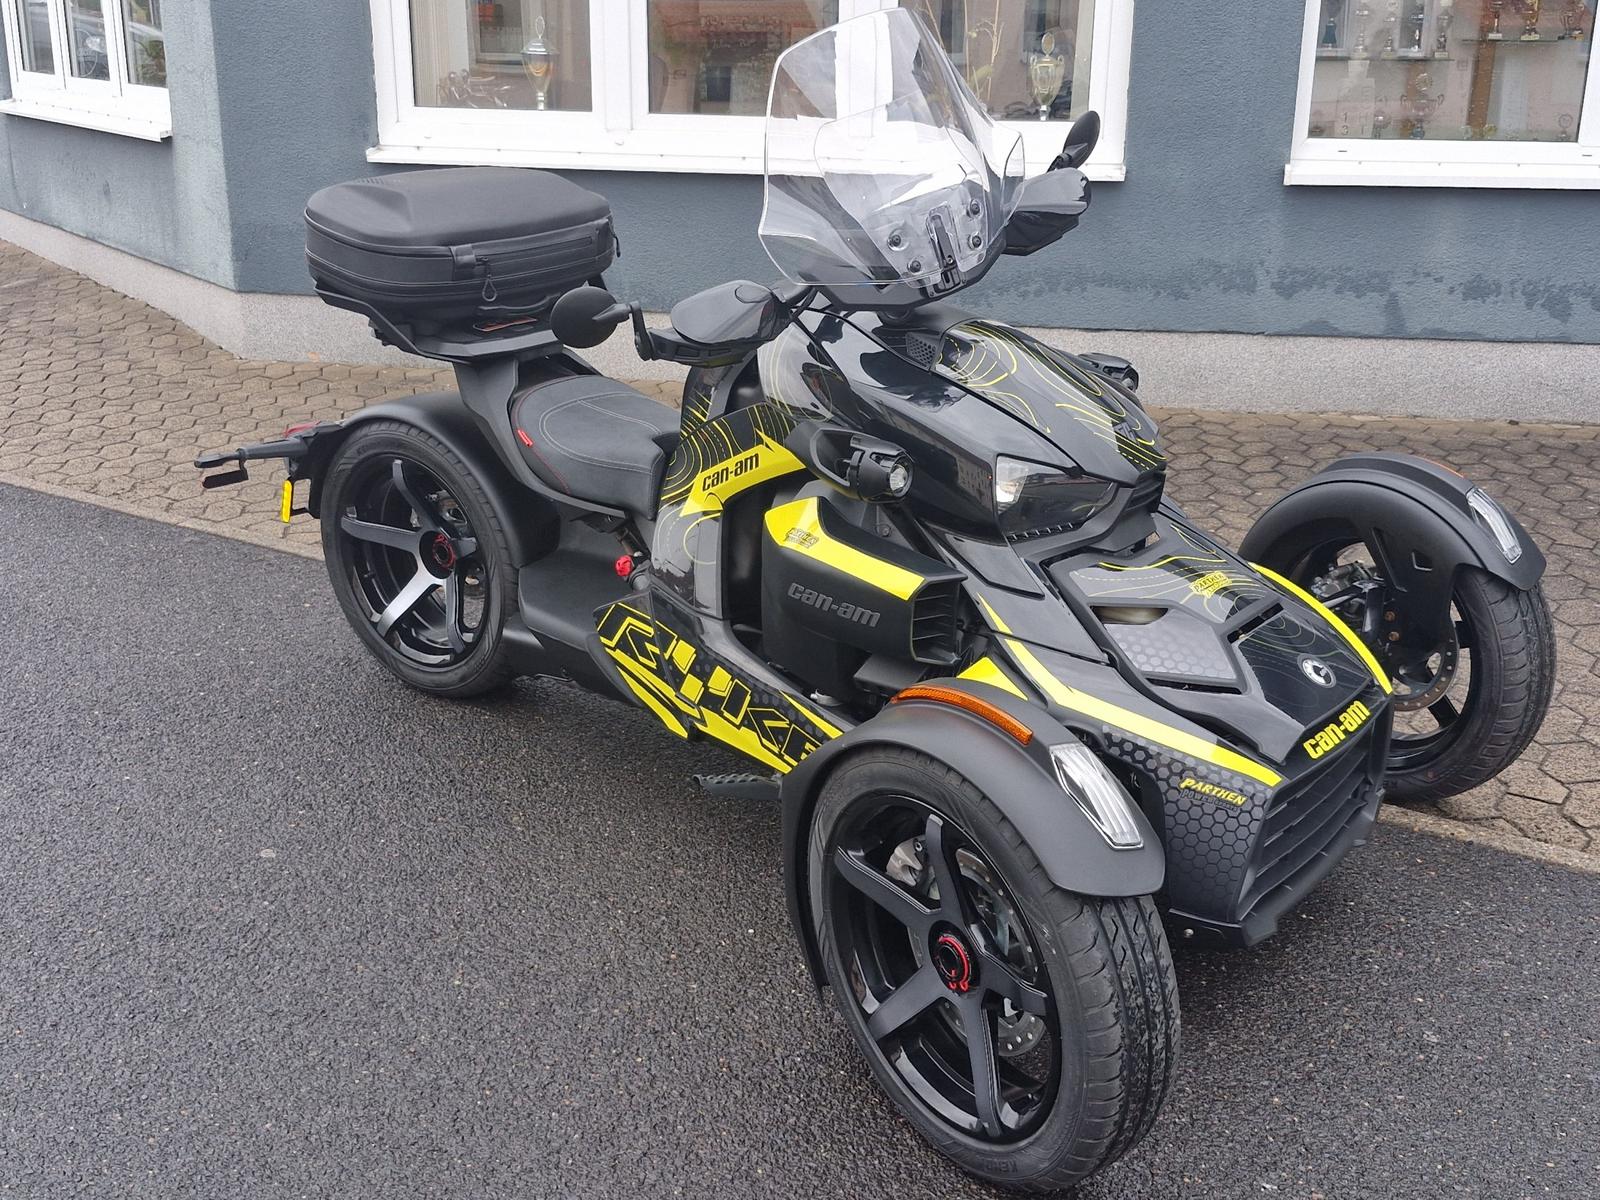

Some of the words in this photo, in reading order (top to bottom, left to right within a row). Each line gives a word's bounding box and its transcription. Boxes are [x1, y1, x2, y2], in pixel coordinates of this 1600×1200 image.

[702, 453, 760, 492] can-am
[788, 583, 880, 627] can-am
[1303, 701, 1371, 758] can-am
[1180, 777, 1247, 805] PARTHEN
